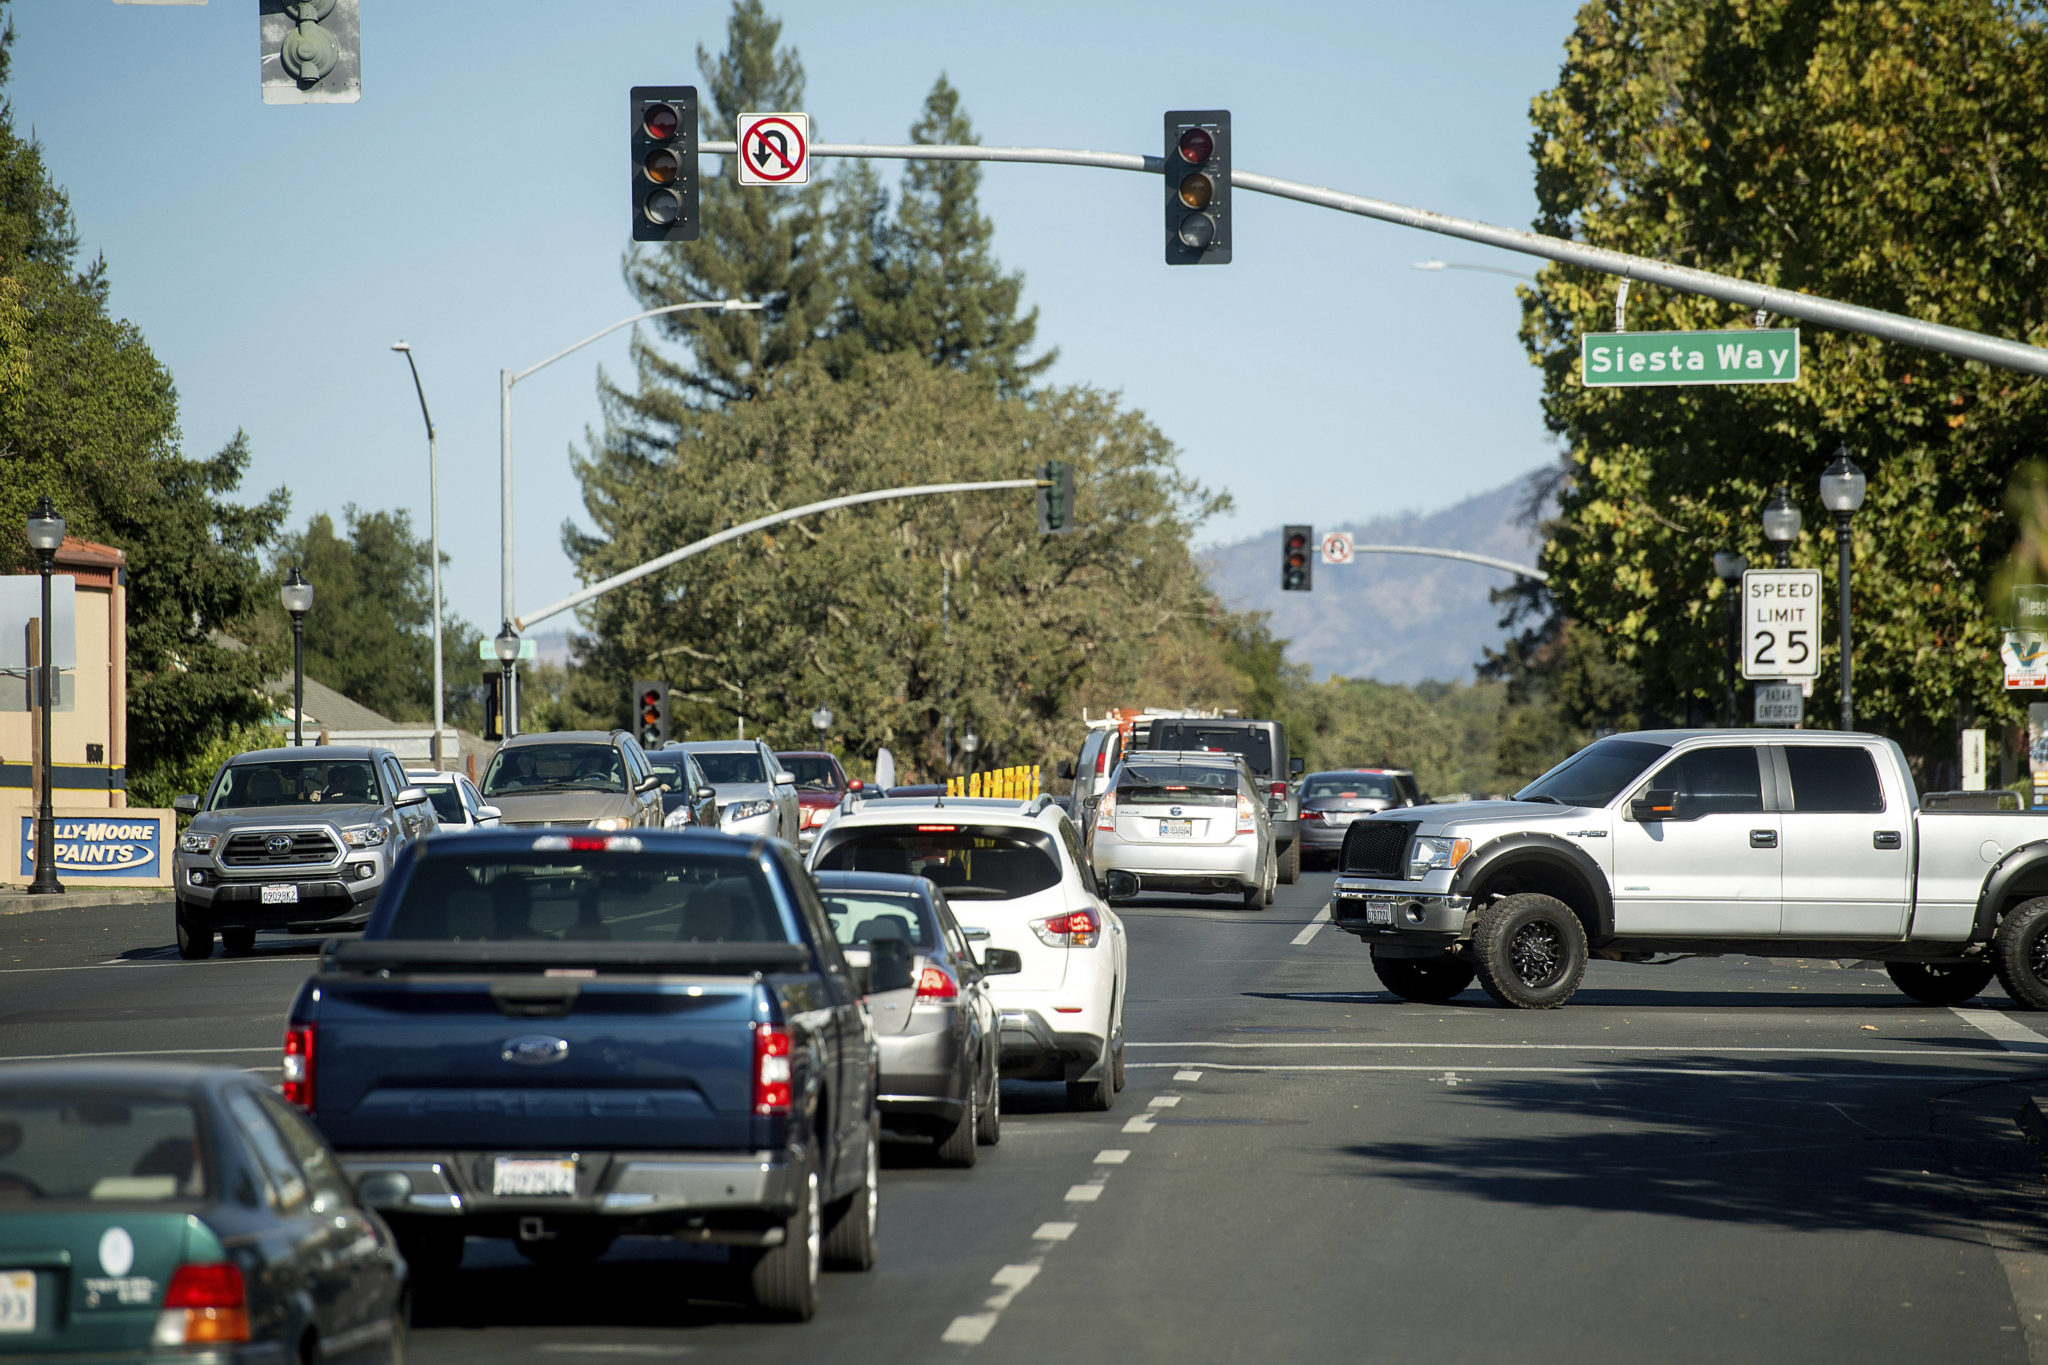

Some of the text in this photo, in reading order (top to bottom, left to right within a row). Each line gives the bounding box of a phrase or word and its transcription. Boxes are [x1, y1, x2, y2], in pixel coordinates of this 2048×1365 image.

[1591, 344, 1789, 375] Siesta Way
[1751, 584, 1814, 598] SPEED
[1757, 608, 1805, 622] LIMIT
[1754, 630, 1809, 664] 25
[1765, 688, 1792, 701] RADAR
[1759, 704, 1799, 718] ENFORCED
[27, 823, 155, 841] LLY-MOORE
[54, 843, 134, 863] PAINTS
